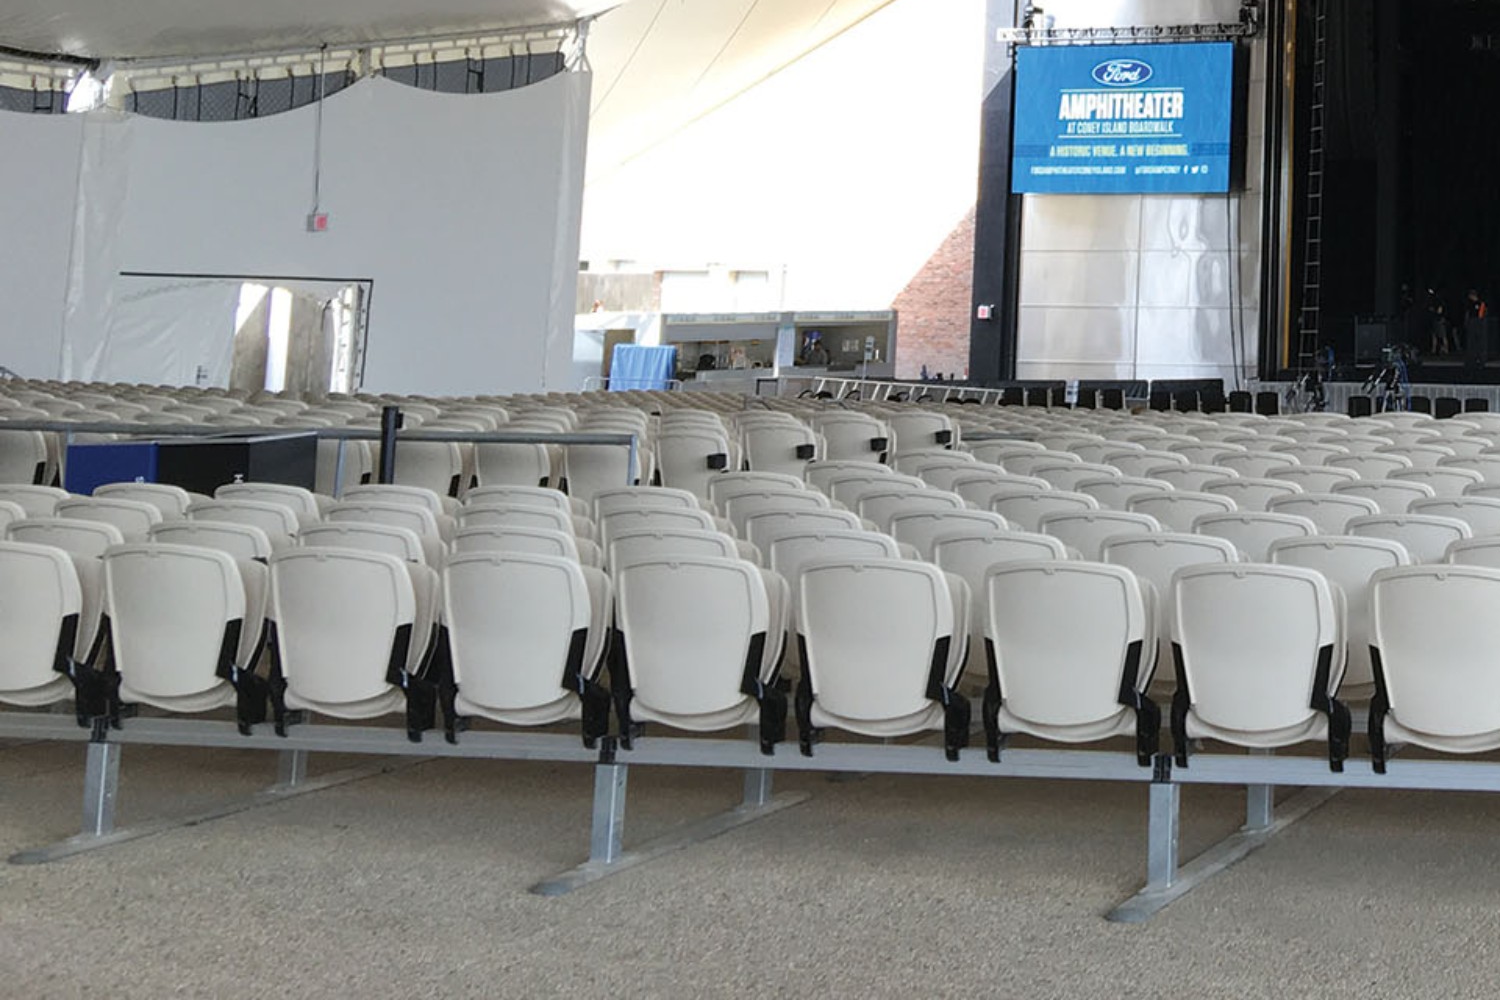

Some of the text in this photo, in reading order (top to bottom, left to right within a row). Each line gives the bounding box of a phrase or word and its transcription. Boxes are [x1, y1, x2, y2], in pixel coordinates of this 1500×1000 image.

[1102, 62, 1142, 82] Ford
[1059, 91, 1184, 121] AMPHITHEATER
[1066, 120, 1174, 134] AT CONEY ISLAND BOARDWALK
